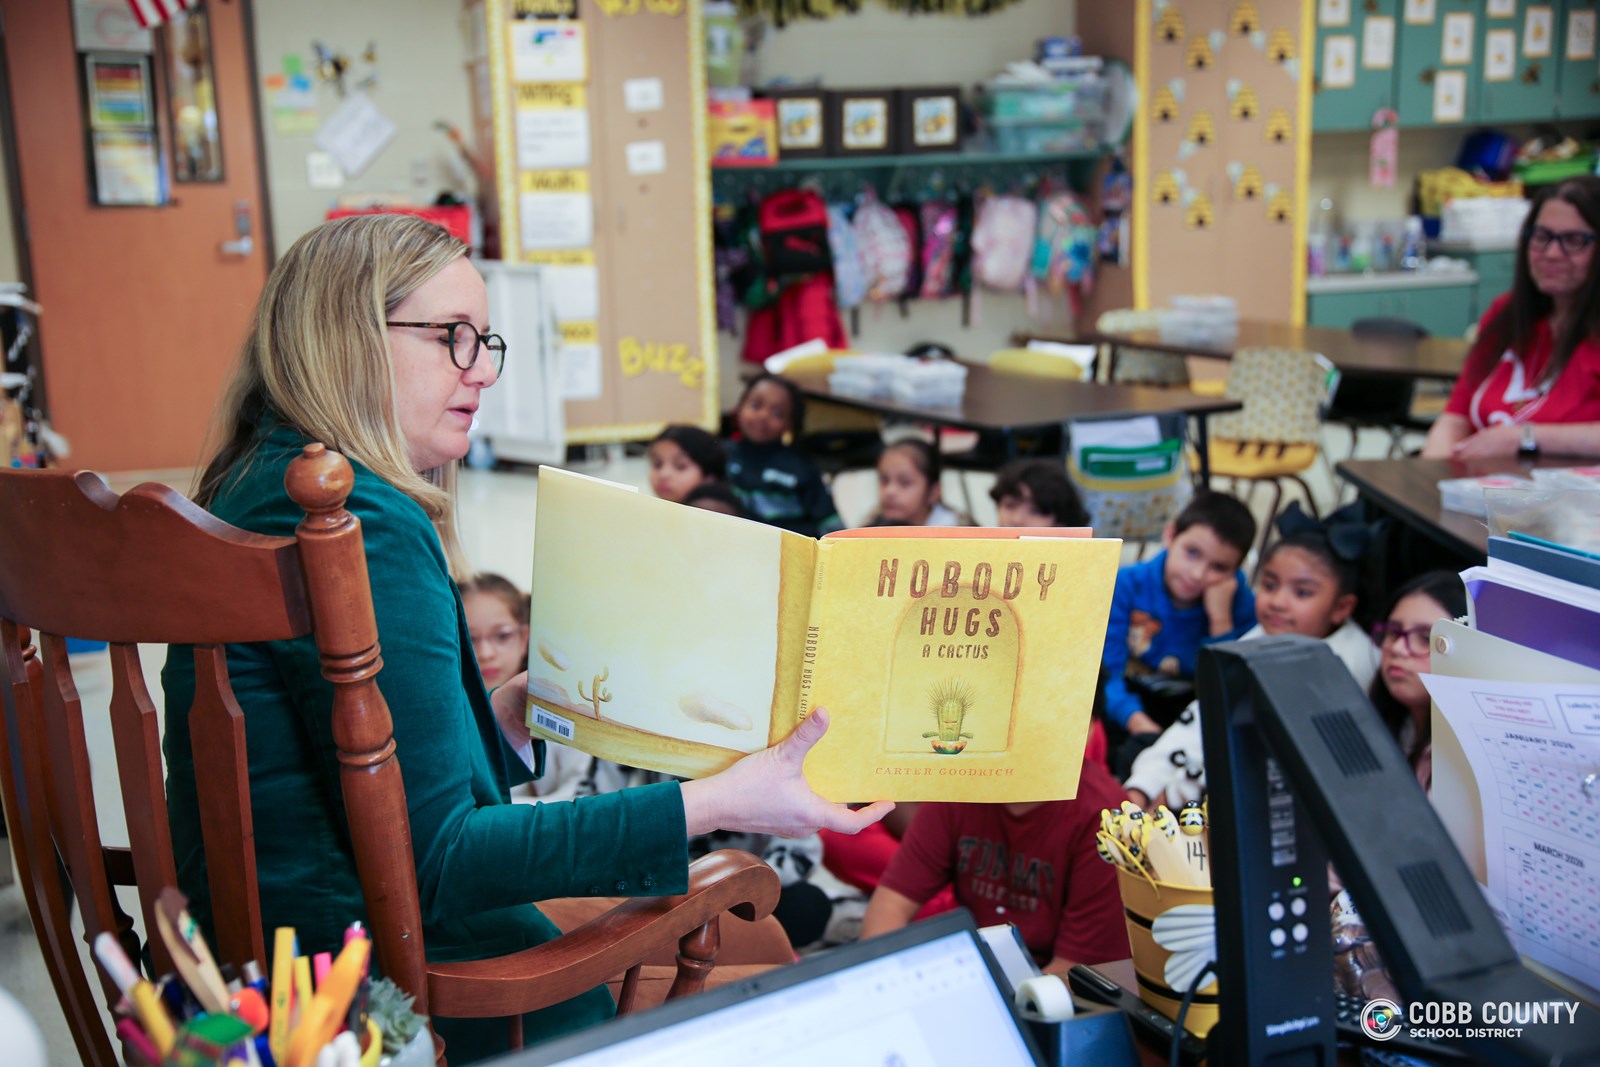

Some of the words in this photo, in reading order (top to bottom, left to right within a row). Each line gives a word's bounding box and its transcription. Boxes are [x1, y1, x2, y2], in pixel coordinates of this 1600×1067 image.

[877, 557, 1058, 601] NOBODY
[920, 606, 1002, 638] HUGS
[804, 625, 820, 665] NOBODY
[921, 643, 931, 658] A
[937, 643, 989, 660] CACTUS
[801, 668, 813, 690] HUGS
[1505, 732, 1548, 745] JANUARY
[875, 766, 933, 776] CARTER
[939, 766, 1015, 777] GOODRICH
[1186, 840, 1207, 871] 14
[1533, 841, 1564, 860] MARCH
